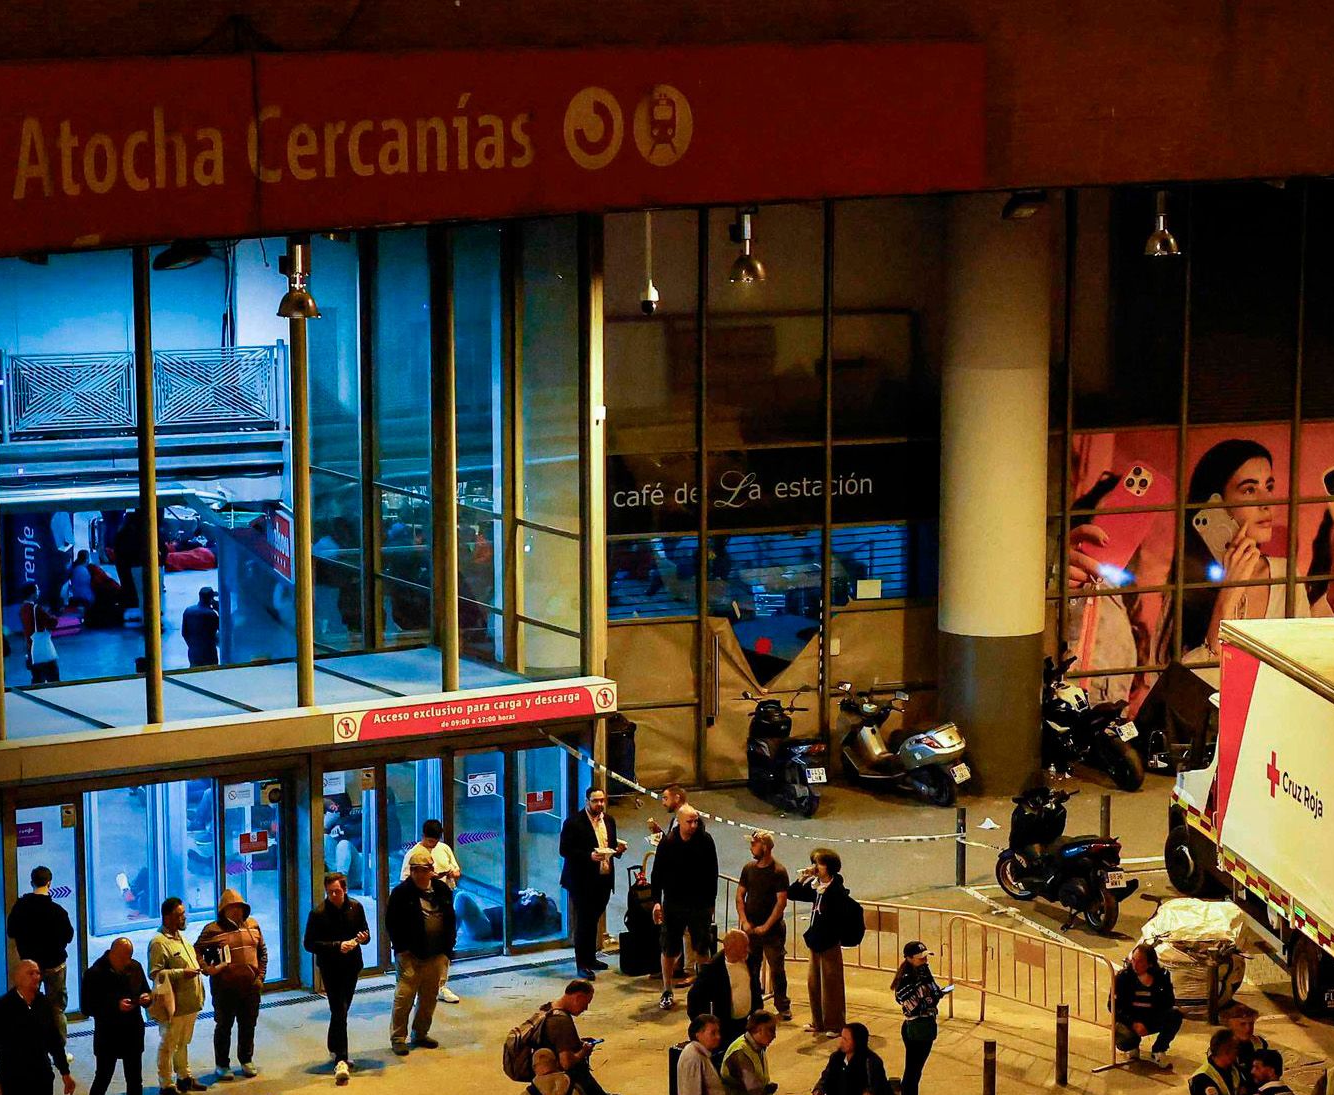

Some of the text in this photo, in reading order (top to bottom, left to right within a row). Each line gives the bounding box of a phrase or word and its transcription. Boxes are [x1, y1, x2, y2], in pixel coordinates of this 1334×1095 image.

[13, 92, 533, 199] Atocha Cercanías
[613, 470, 873, 508] café de La estación
[18, 526, 41, 583] renfe
[373, 690, 580, 724] Acceso exclusivo para carga y descarga
[450, 718, 470, 727] 09:00
[477, 715, 496, 724] 12:00
[498, 713, 516, 722] horas
[1282, 771, 1324, 819] Cruz Roja
